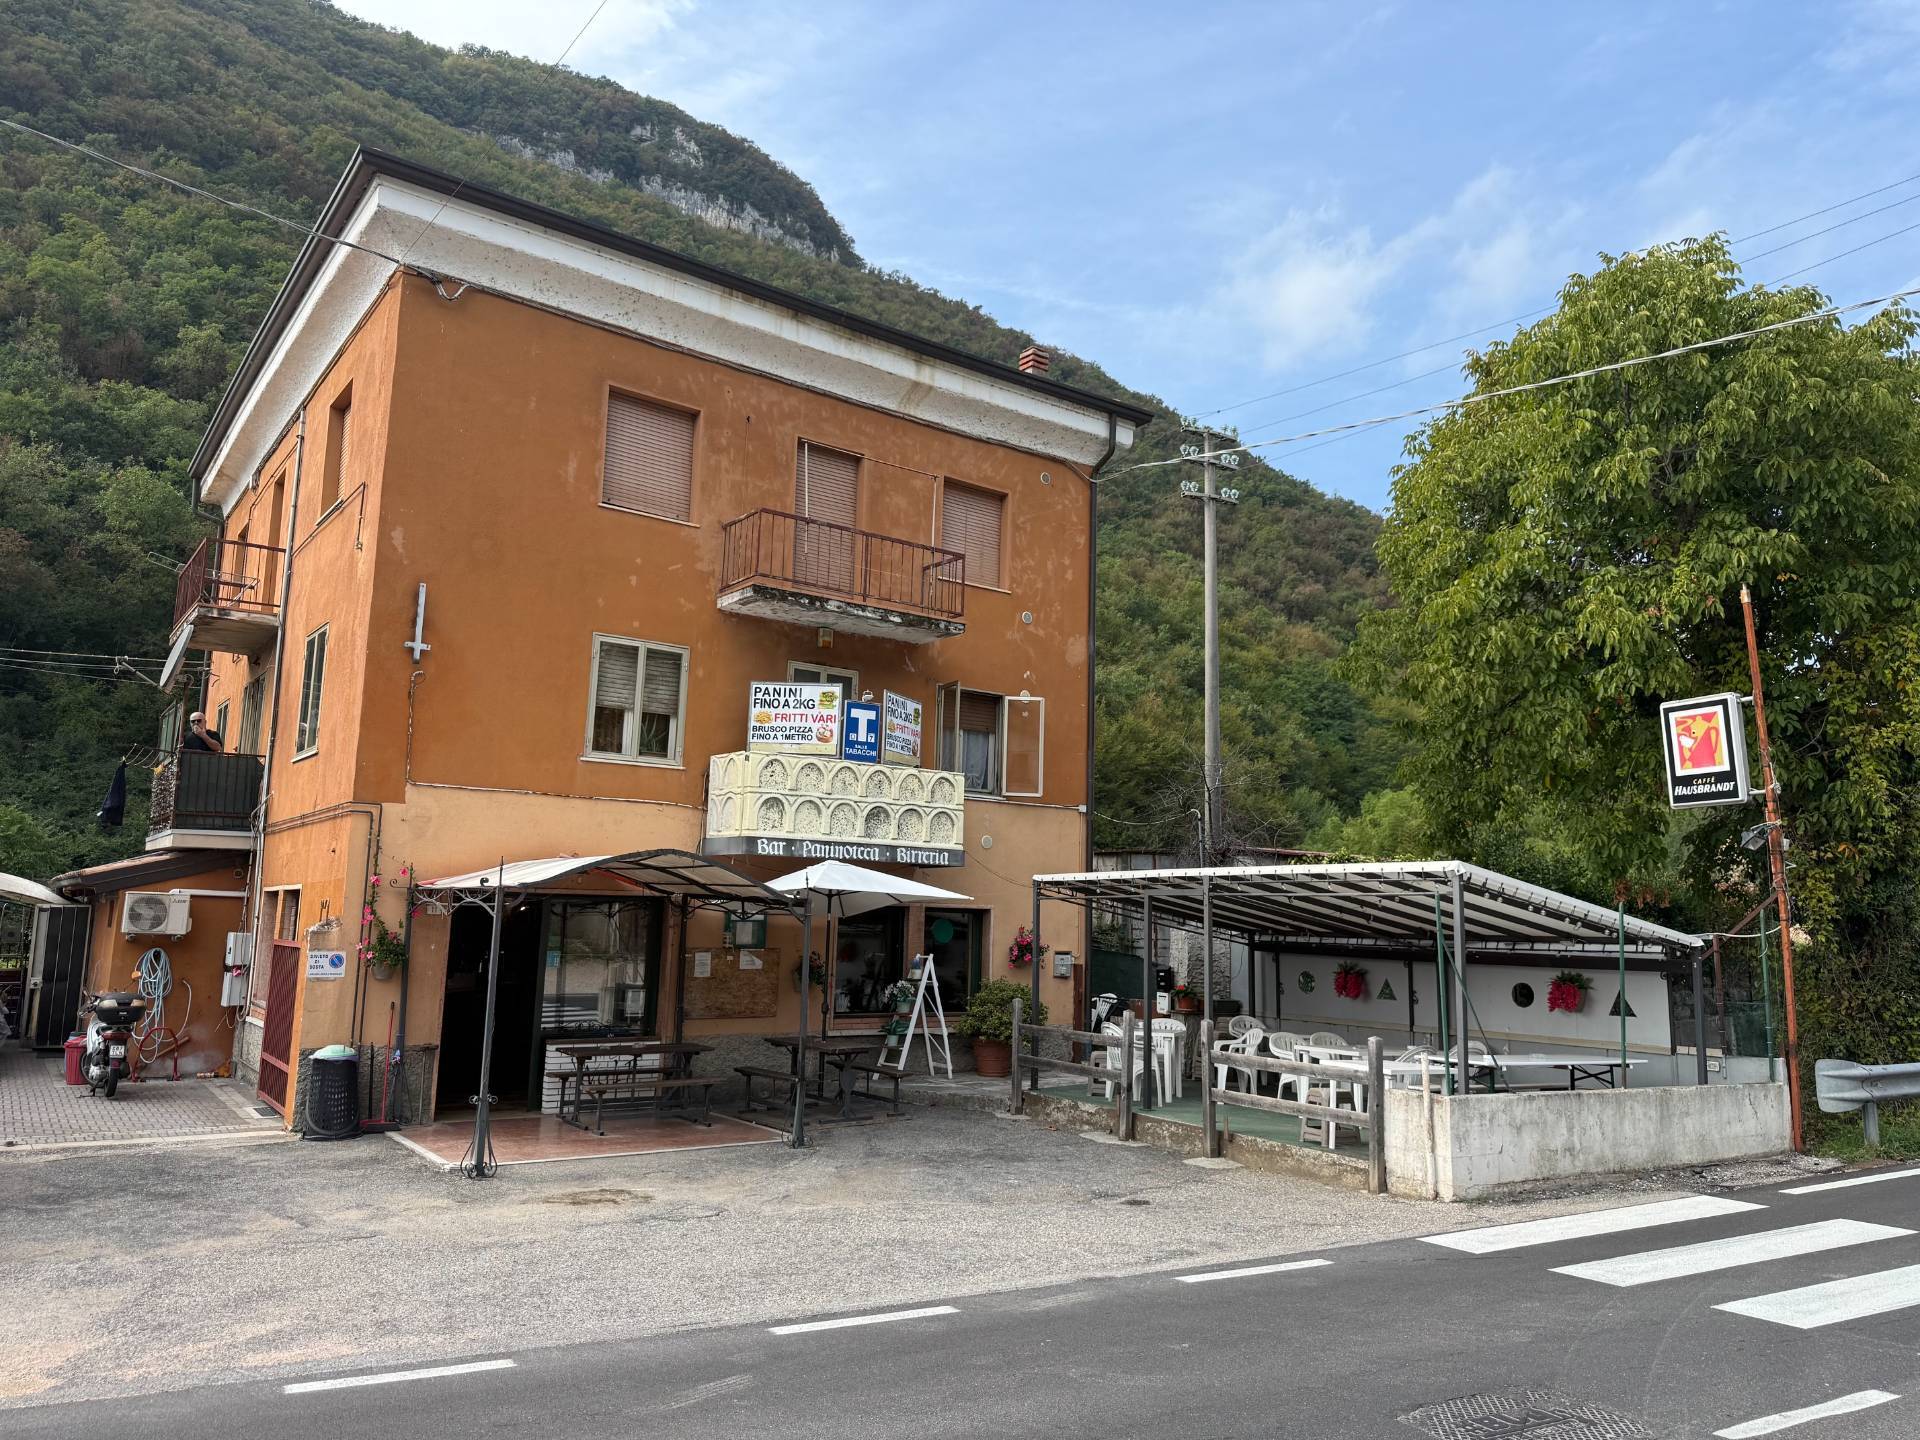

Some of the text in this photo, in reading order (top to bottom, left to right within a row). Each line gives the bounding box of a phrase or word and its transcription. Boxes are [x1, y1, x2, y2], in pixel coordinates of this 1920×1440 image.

[754, 686, 803, 698] PANINI
[753, 698, 816, 710] FINO A 2KG
[888, 695, 908, 711] PANINI
[774, 712, 837, 724] FRITTI VARI
[887, 706, 899, 719] FINO
[899, 711, 904, 721] A
[752, 725, 814, 734] BRUSCO PIZZA
[850, 708, 877, 742] T
[751, 733, 771, 741] FINO
[845, 747, 877, 757] TABACCHI
[1674, 781, 1736, 796] HAUSBRANDT
[757, 838, 949, 865] Bar Paninoteca Birreria
